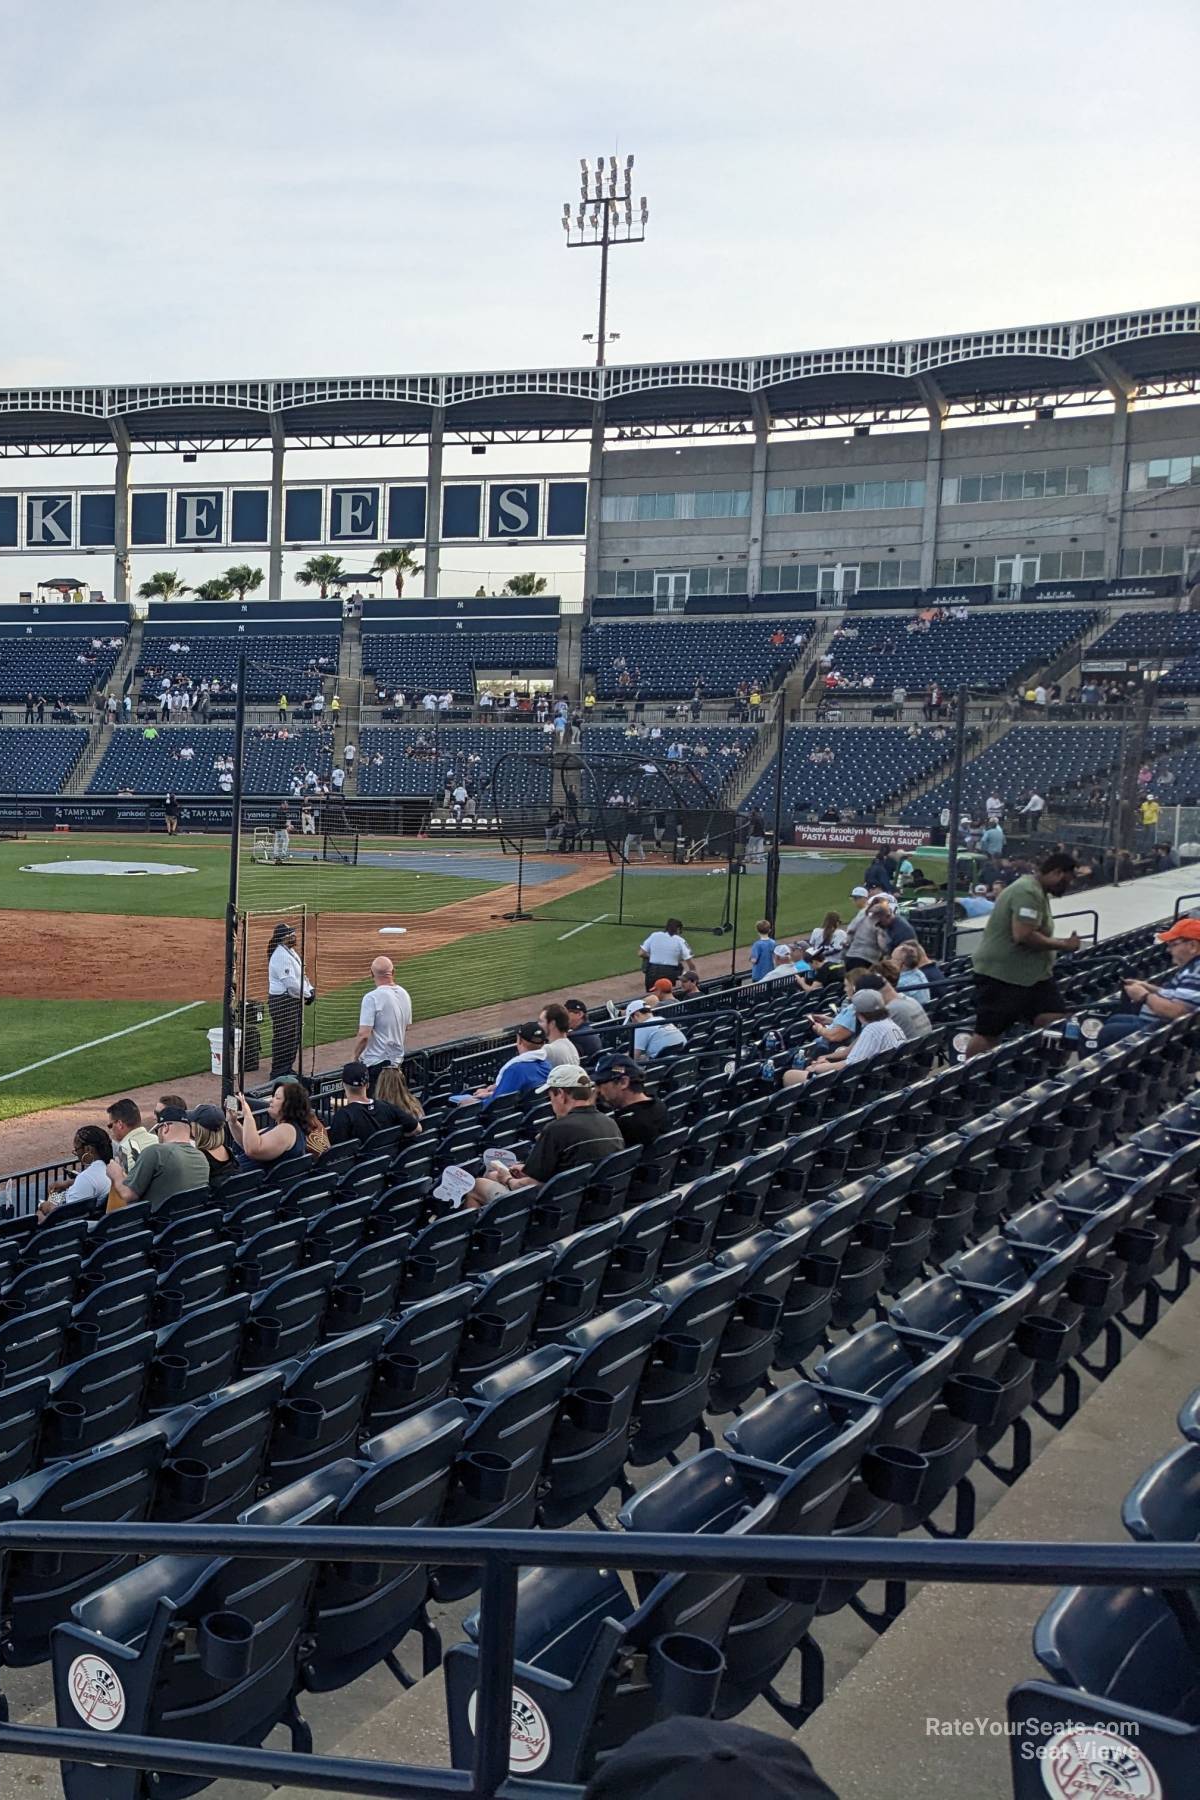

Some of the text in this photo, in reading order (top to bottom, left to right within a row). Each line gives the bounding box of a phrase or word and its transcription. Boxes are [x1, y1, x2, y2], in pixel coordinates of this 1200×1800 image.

[794, 825, 826, 833] Michaels
[830, 826, 864, 836] Brooklyn
[865, 828, 894, 836] Michaels
[898, 829, 931, 839] Brooklyn
[802, 833, 856, 842] PASTA SAUCE
[872, 836, 923, 846] PASTA SAUCE
